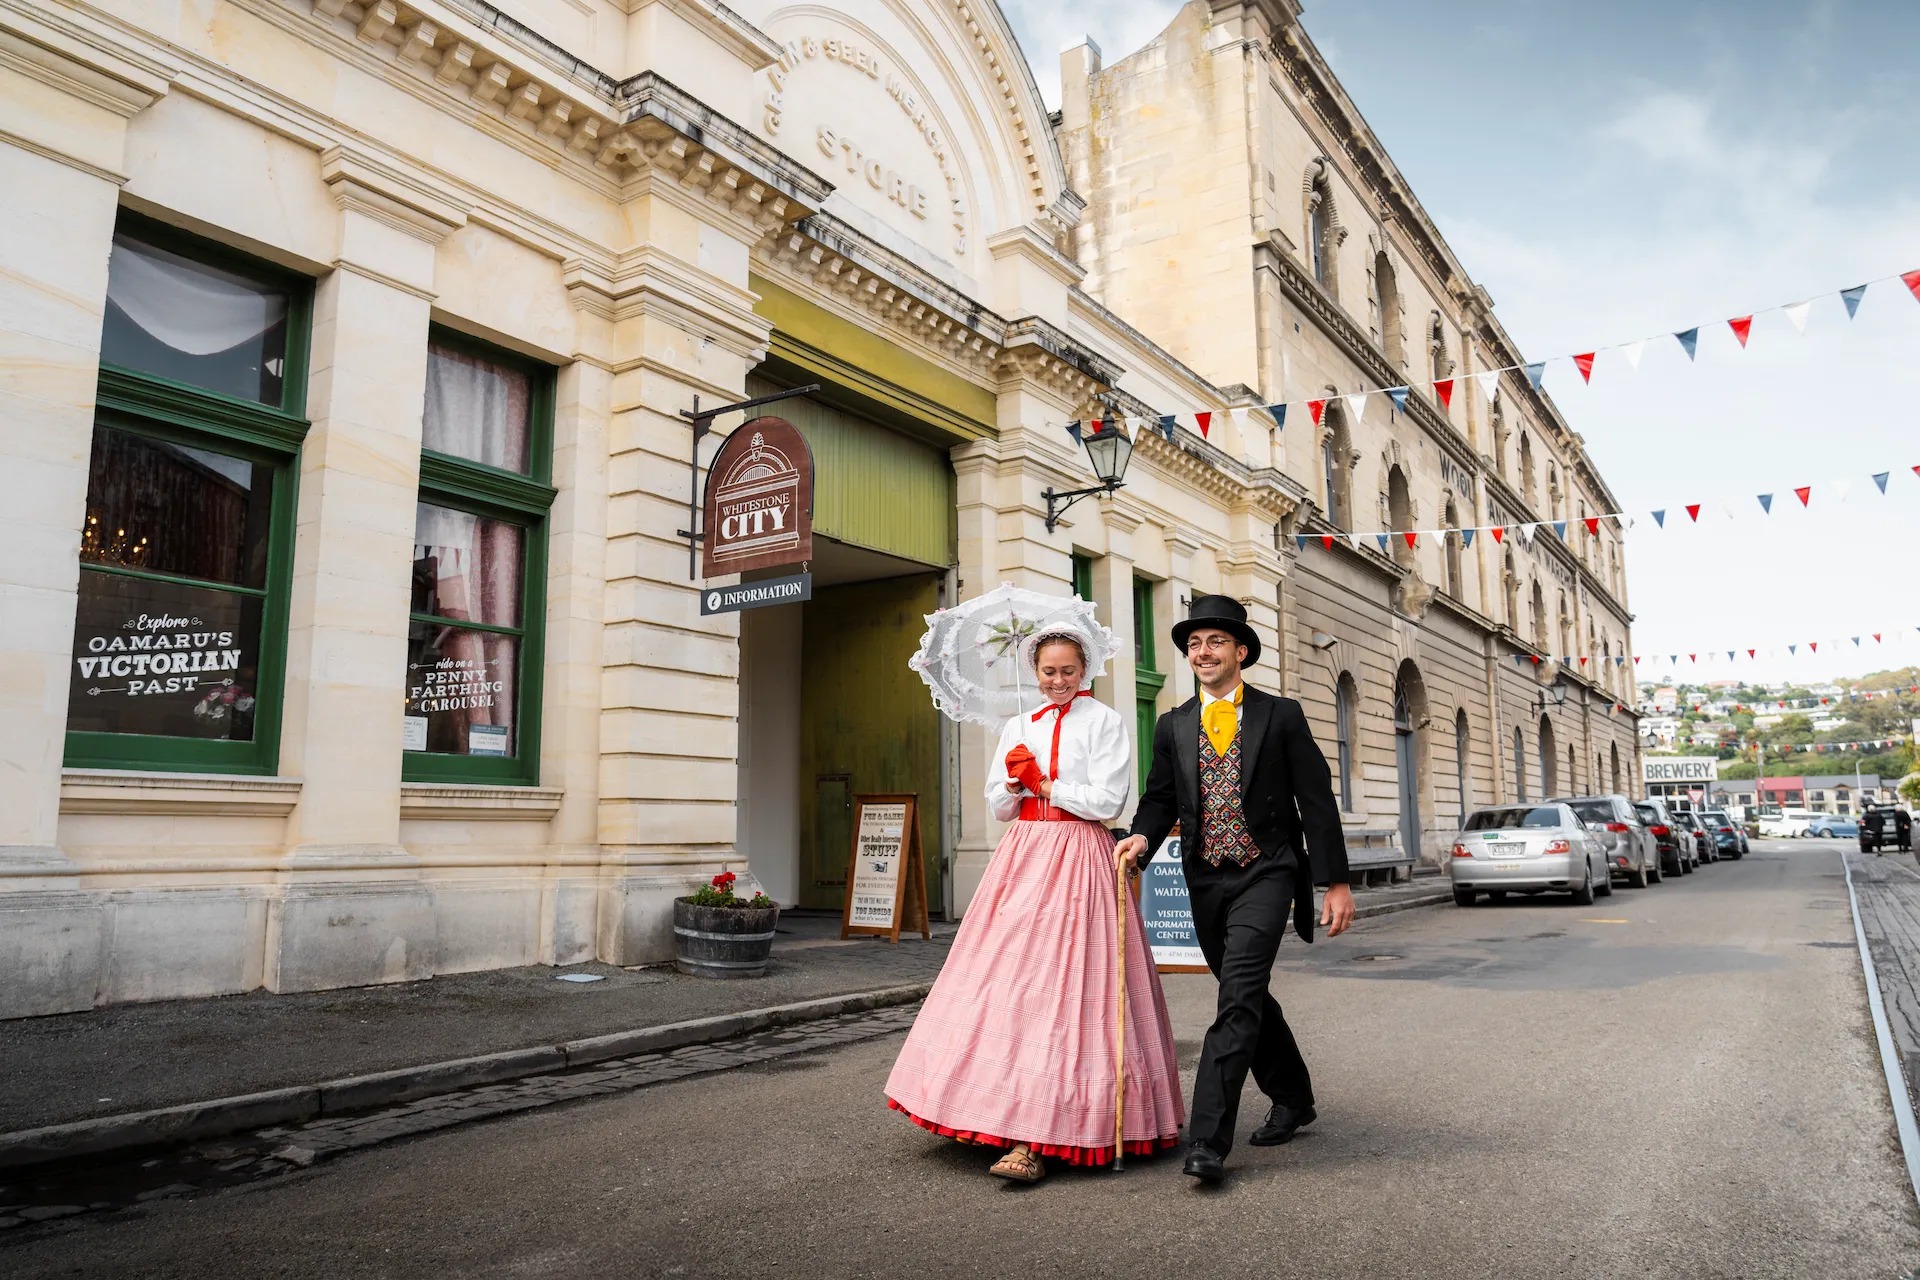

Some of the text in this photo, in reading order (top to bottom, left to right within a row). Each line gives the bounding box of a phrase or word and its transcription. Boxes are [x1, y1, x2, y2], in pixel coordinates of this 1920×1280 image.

[764, 41, 800, 137] GRAIN
[801, 36, 818, 59] &
[822, 38, 880, 80] SEED
[816, 122, 929, 221] STORE
[1438, 449, 1475, 504] WOOL
[722, 492, 790, 517] WHITESTONE
[721, 504, 790, 540] CITY
[724, 582, 802, 605] INFORMATION
[137, 613, 189, 633] Explore
[88, 631, 233, 653] OAMARU'S
[77, 650, 241, 679] VICTORIAN
[435, 657, 454, 669] ride
[455, 661, 466, 669] on
[127, 676, 199, 696] PAST
[424, 669, 487, 685] PENNY
[411, 680, 503, 699] FARTHING
[420, 694, 495, 713] CAROUSEL
[1646, 763, 1713, 779] BREWERY.
[862, 844, 899, 857] STUFF
[1154, 865, 1184, 876] ŌAMA
[1154, 887, 1190, 897] WAITA
[1157, 910, 1192, 918] VISITOR
[1143, 920, 1195, 929] INFORMATI
[1156, 931, 1191, 940] CENTRE
